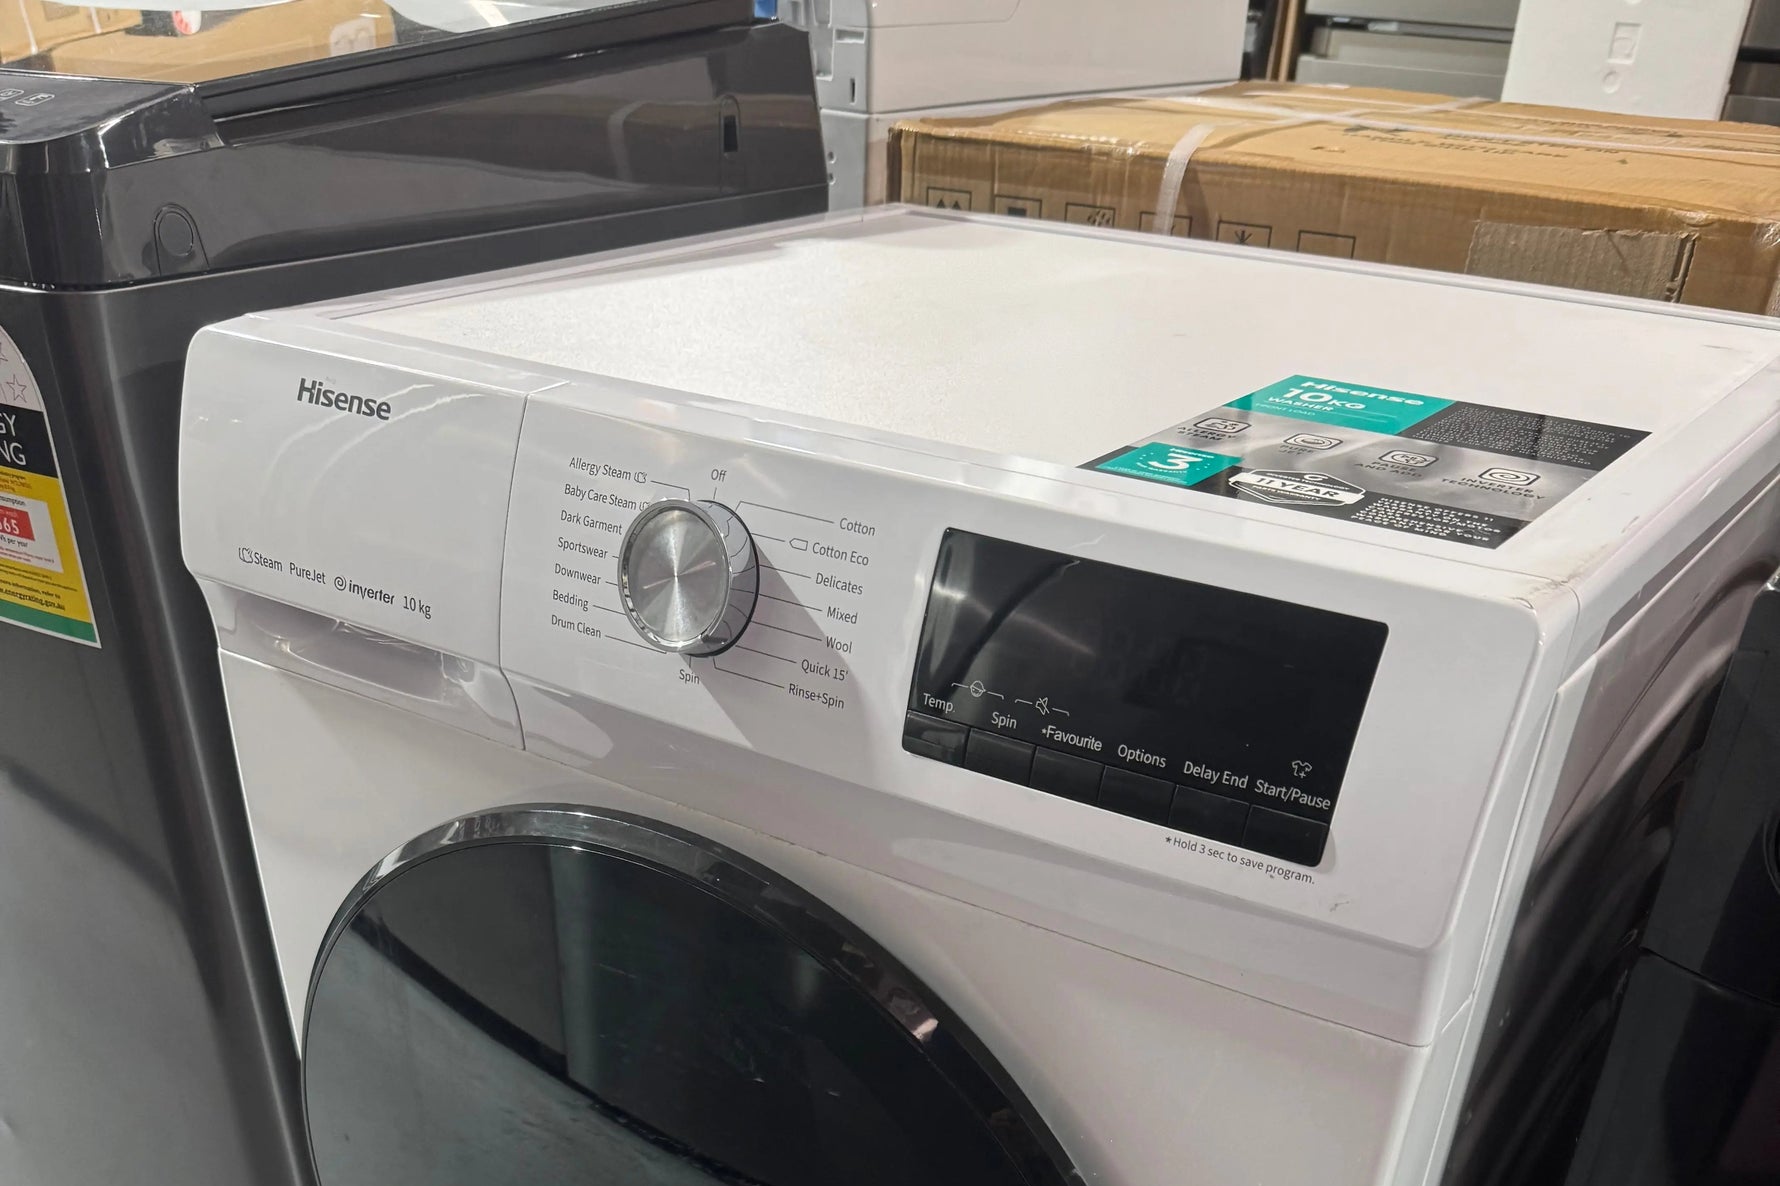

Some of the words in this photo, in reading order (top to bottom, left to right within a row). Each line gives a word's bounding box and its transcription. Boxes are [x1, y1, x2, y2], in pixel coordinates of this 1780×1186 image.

[297, 377, 392, 421] Hisense
[1268, 396, 1334, 411] WASHER
[1301, 381, 1424, 406] Hisense
[569, 457, 601, 477] Allergy
[602, 464, 631, 481] Steam
[1148, 453, 1203, 470] 3
[1354, 463, 1386, 471] AND
[1389, 469, 1422, 478] ADD
[1372, 461, 1417, 472] PAUSE
[710, 468, 727, 483] Off
[1461, 478, 1534, 493] INVERTER
[564, 483, 587, 501] Baby
[587, 489, 608, 504] Care
[608, 494, 637, 510] Steam
[1276, 481, 1341, 498] YEAR
[1441, 478, 1546, 500] TECHNOLOGY
[0, 517, 20, 534] 65
[560, 509, 581, 525] Dark
[583, 515, 622, 535] Garment
[840, 517, 876, 536] Cotton
[557, 537, 608, 559] Sportswear
[812, 542, 848, 561] Cotton
[849, 550, 869, 566] Eco
[554, 563, 601, 585] Downwear
[815, 572, 863, 595] Delicates
[254, 552, 283, 572] Steam
[289, 562, 326, 585] PureJet
[348, 579, 395, 605] inverter
[403, 596, 417, 612] 10
[418, 599, 432, 620] kg
[552, 589, 589, 612] Bedding
[826, 606, 858, 624] Mixed
[551, 614, 575, 631] Drum
[577, 622, 601, 639] Clean
[826, 636, 853, 654] Wool
[679, 669, 700, 684] Spin
[801, 659, 830, 678] Quick
[789, 683, 845, 709] Rinse+Spin
[923, 693, 956, 713] Temp.
[991, 711, 1018, 729] Spin
[1117, 744, 1167, 769] Options
[1183, 760, 1220, 785] Delay
[1222, 771, 1249, 789] End
[1254, 779, 1331, 810] Start/Pause
[1173, 834, 1197, 852] Hold
[1199, 844, 1206, 854] 3
[1207, 848, 1225, 860] sec
[1227, 852, 1238, 863] to
[1239, 857, 1264, 870] save
[1265, 863, 1316, 885] program.
